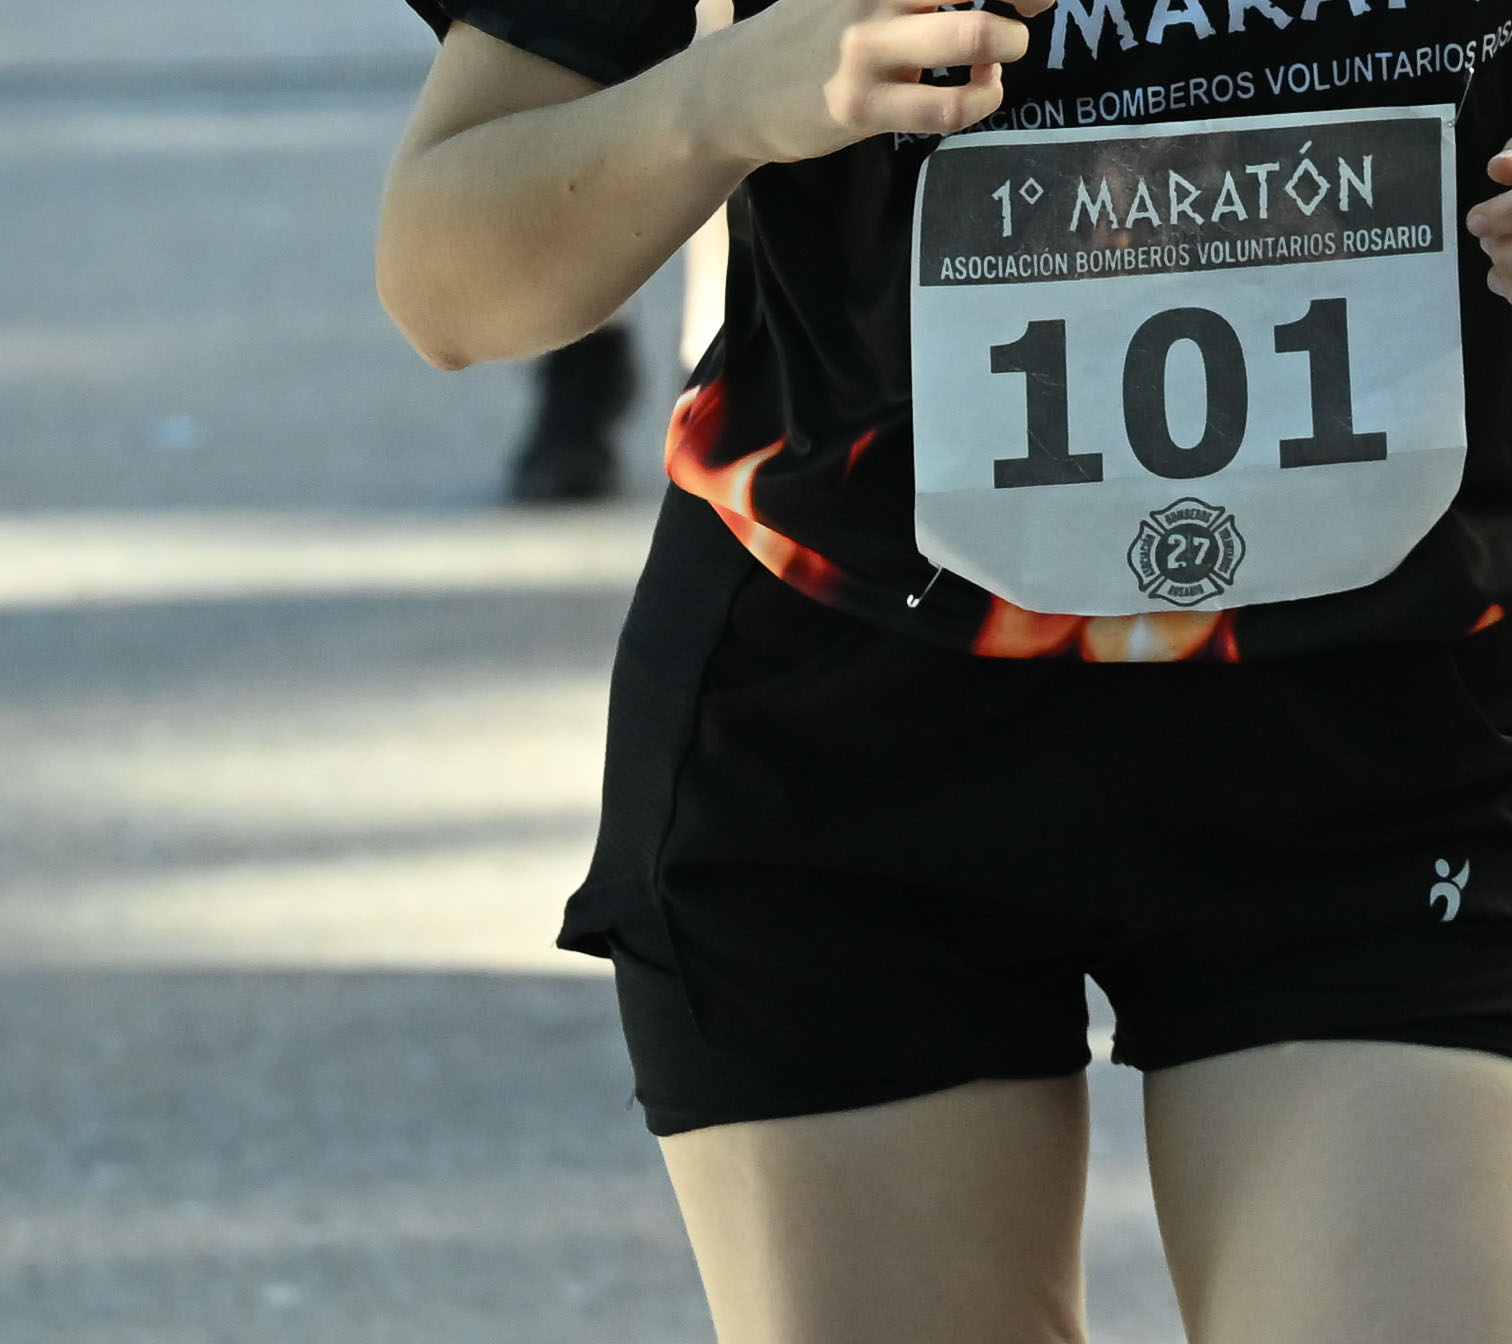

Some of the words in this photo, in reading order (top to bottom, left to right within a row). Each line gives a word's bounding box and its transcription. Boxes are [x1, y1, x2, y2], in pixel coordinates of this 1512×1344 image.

[1077, 72, 1254, 124] BOMBEROS
[1264, 40, 1476, 94] VOLUNTARIOS
[1069, 141, 1374, 231] MARATÓN
[940, 245, 1068, 281] ASOCIACIÓN
[1075, 243, 1189, 274] BOMBEROS
[1197, 233, 1335, 266] VOLUNTARIOS
[1344, 225, 1432, 253] ROSARIO
[989, 298, 1387, 489] 101
[1168, 534, 1210, 568] 27
